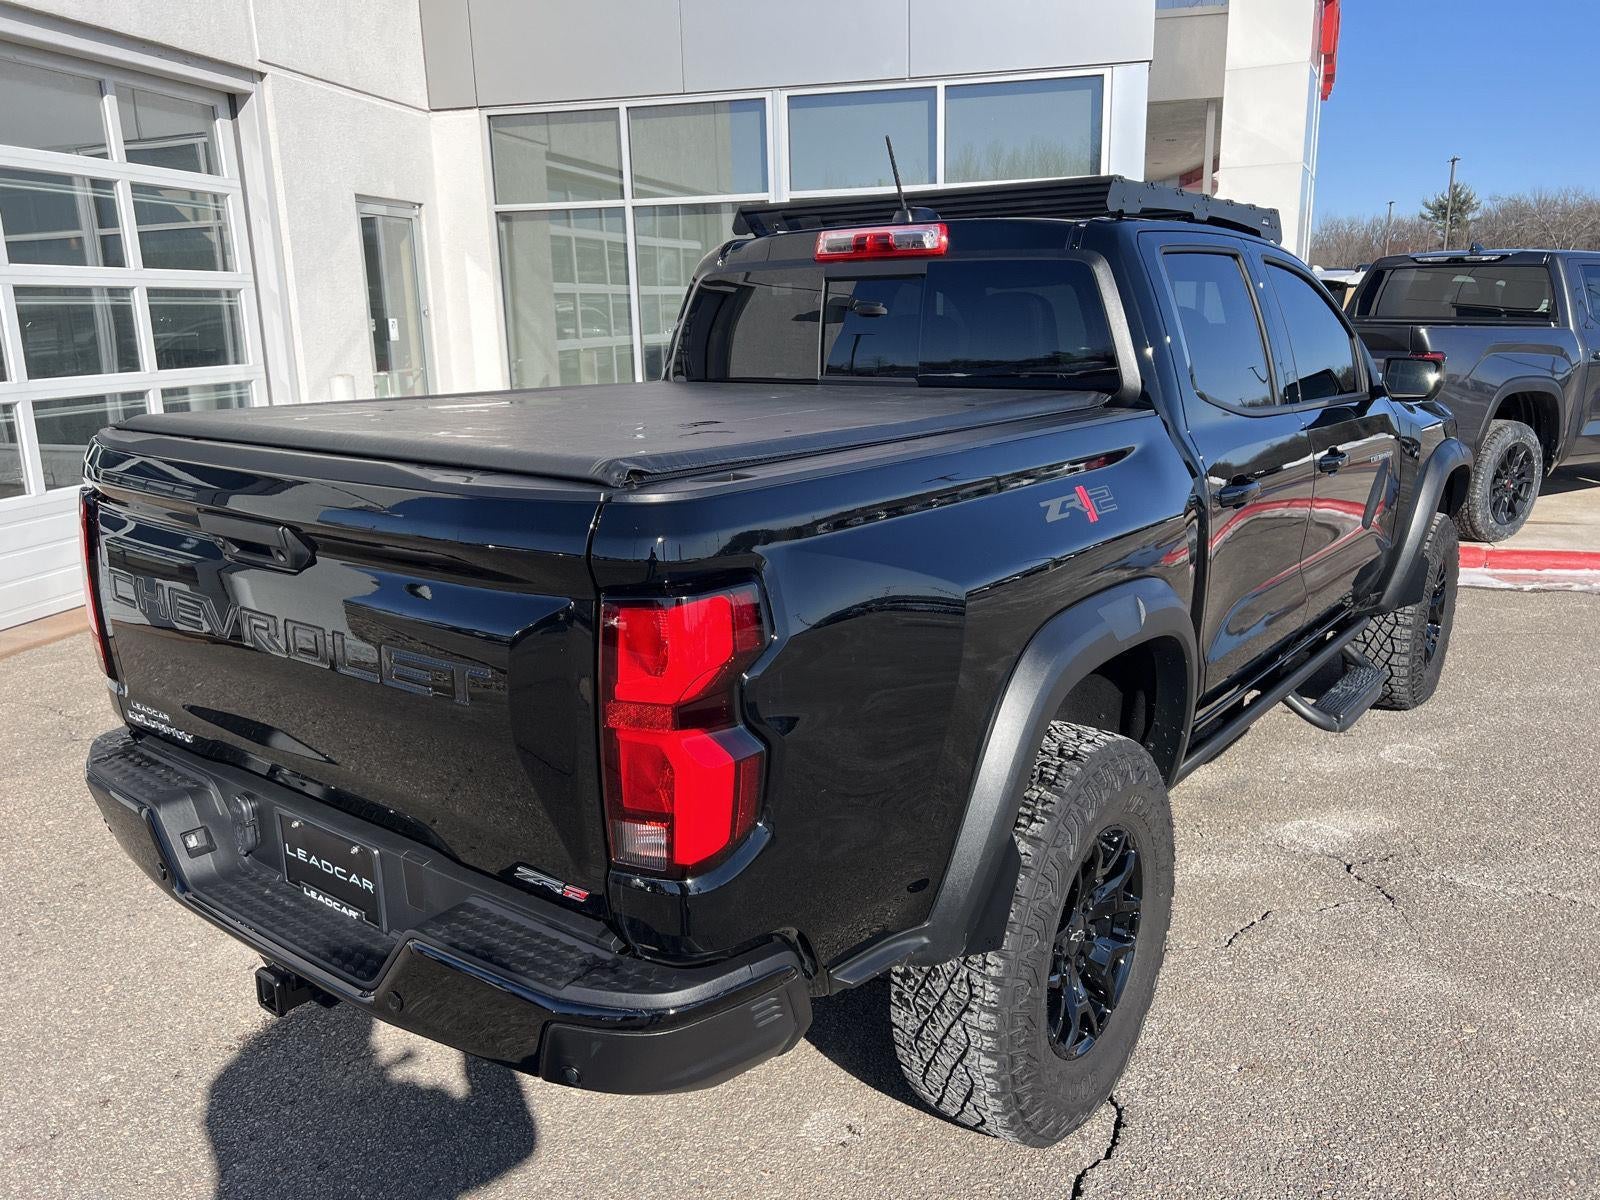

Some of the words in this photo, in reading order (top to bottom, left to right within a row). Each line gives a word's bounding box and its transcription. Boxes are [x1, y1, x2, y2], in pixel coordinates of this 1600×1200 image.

[1039, 485, 1118, 523] ZR2
[109, 567, 492, 706] CHEVROLET
[131, 700, 171, 722] LEADCAR
[285, 843, 375, 894] LEADCAR
[514, 865, 591, 903] ZR2
[303, 887, 359, 919] LEADCAR
